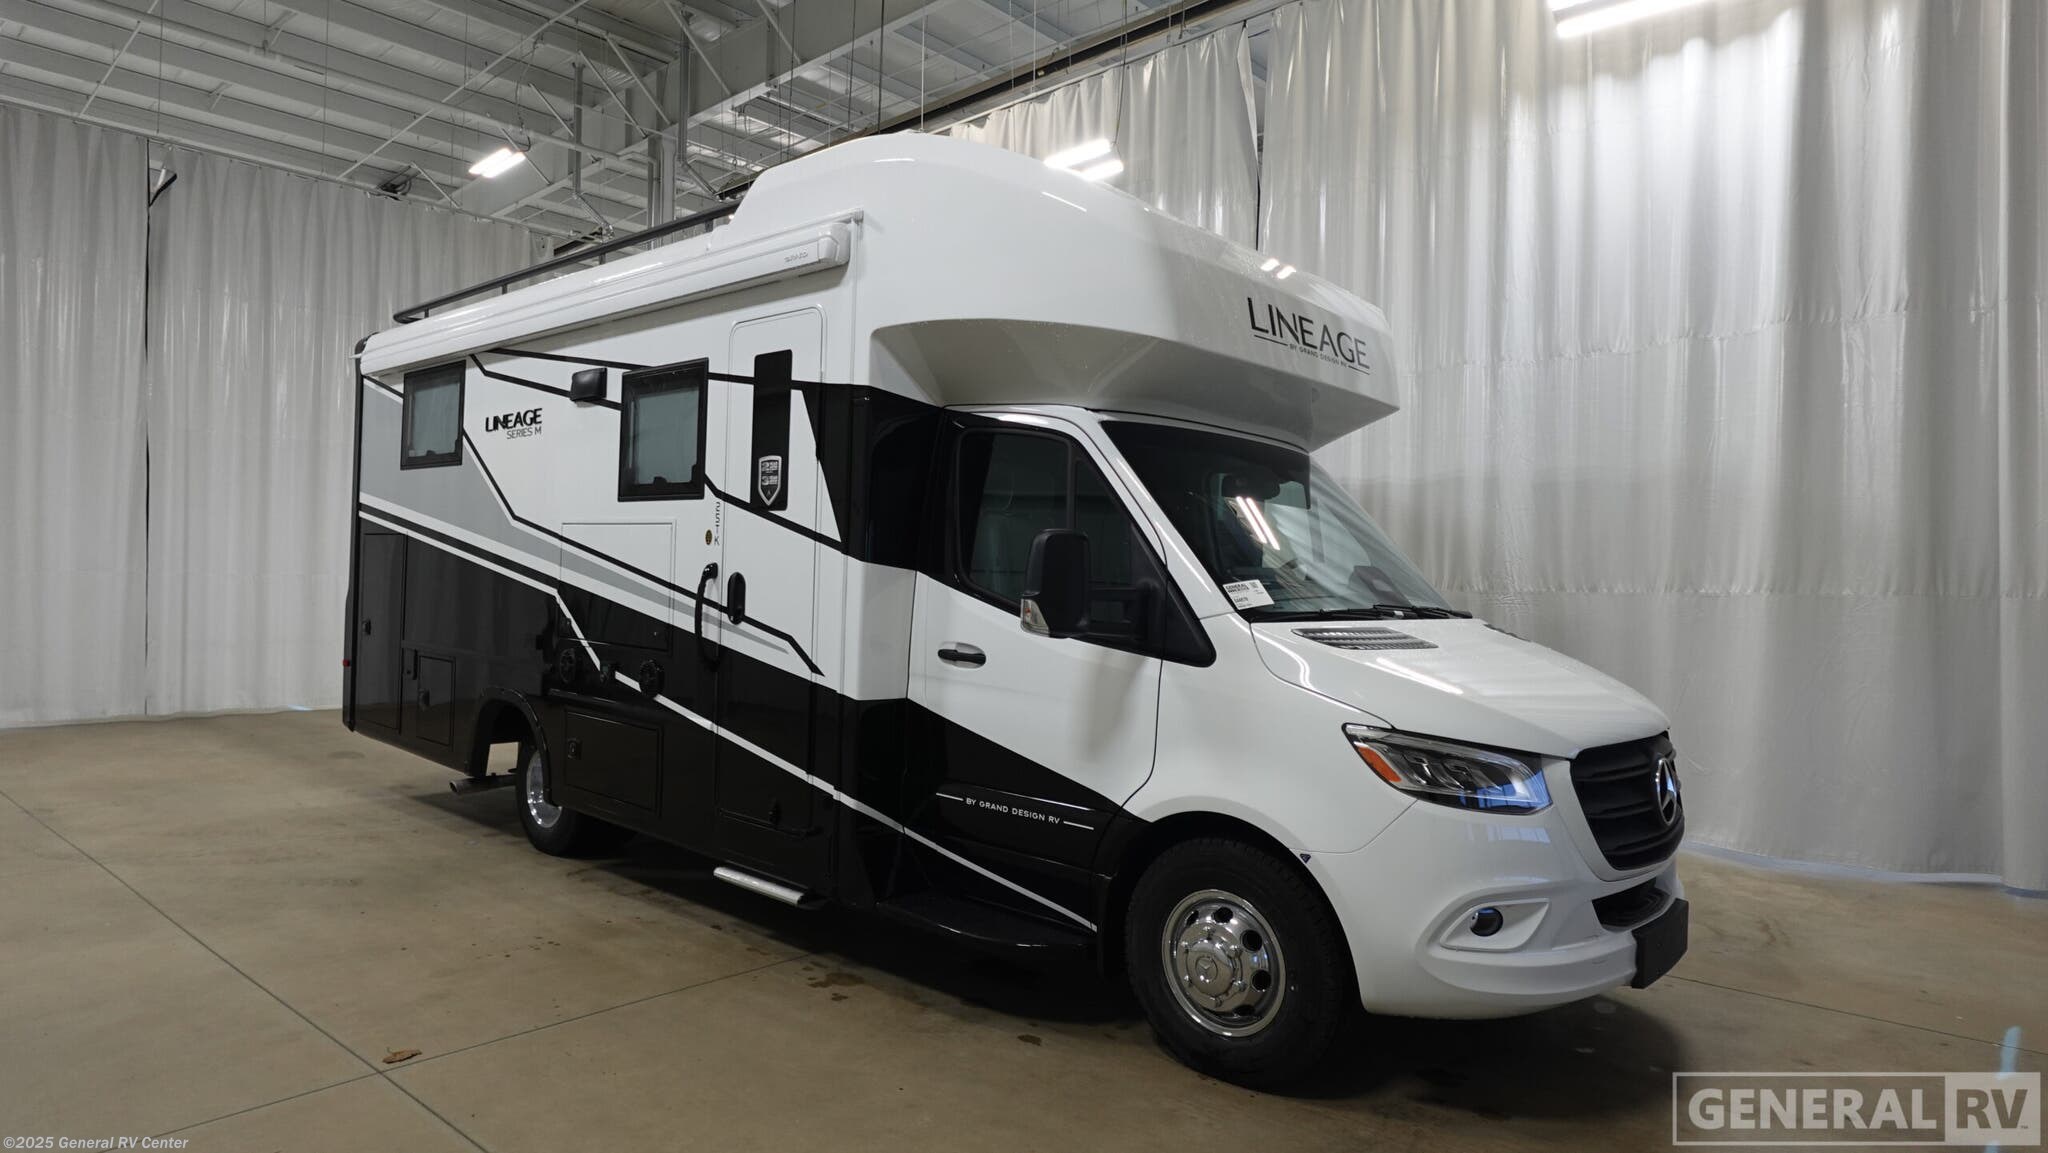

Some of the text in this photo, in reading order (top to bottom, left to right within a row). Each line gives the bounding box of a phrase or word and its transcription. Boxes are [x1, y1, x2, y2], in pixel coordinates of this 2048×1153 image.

[1247, 297, 1370, 370] LINEAGE
[485, 407, 543, 432] LINEAGE
[506, 426, 542, 440] SERIES M
[966, 797, 1061, 825] BY GRAND DESIGN RV
